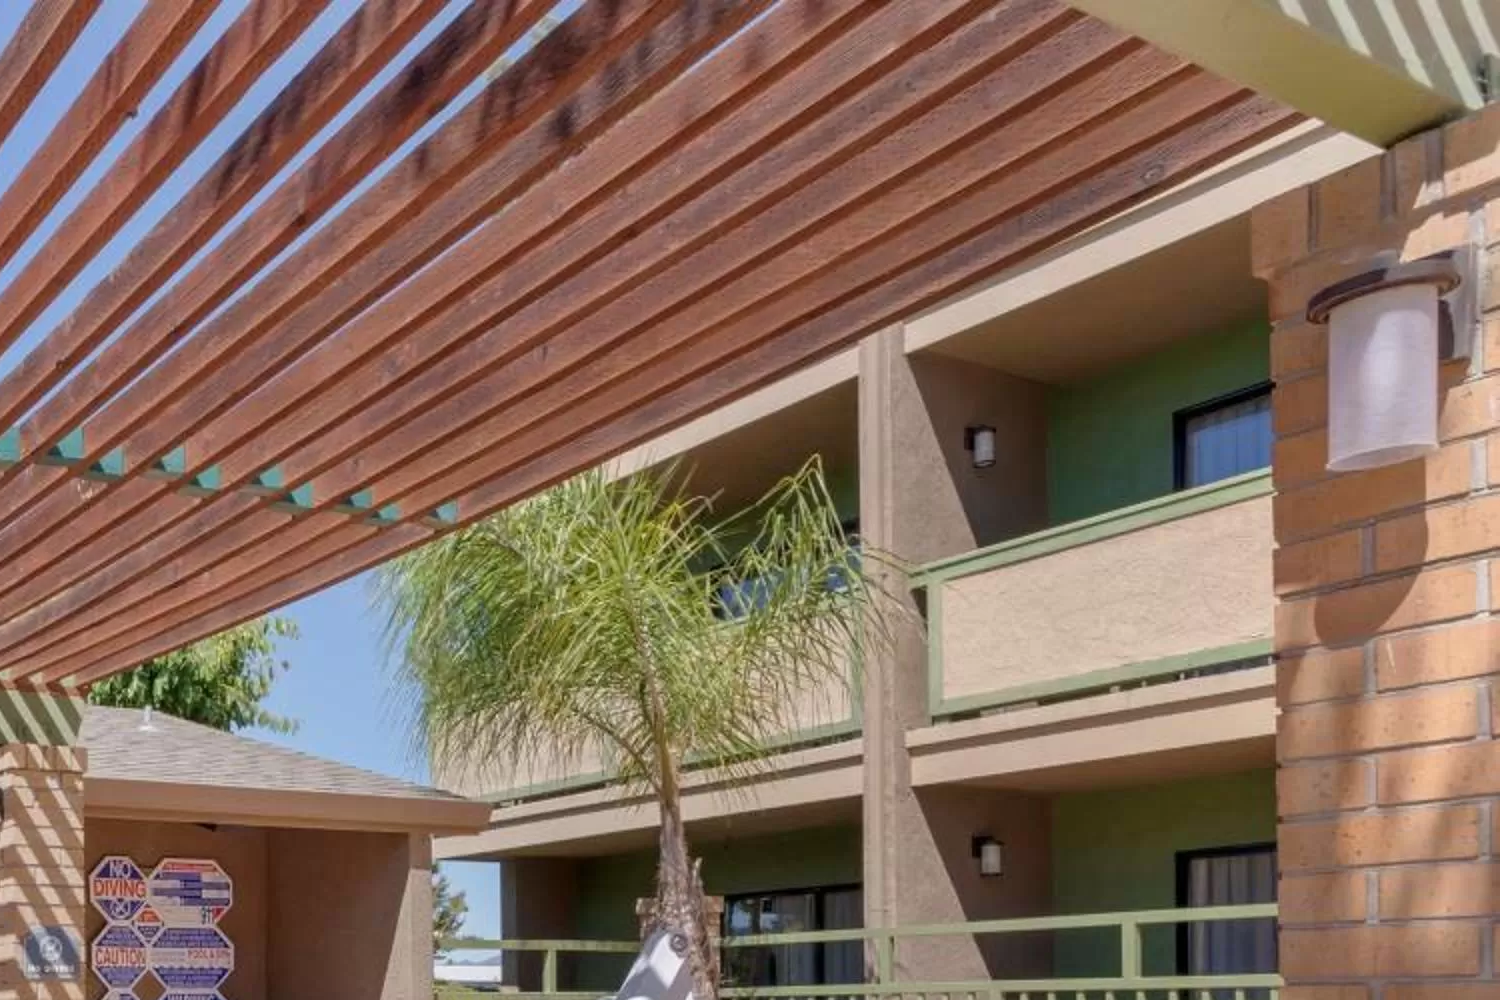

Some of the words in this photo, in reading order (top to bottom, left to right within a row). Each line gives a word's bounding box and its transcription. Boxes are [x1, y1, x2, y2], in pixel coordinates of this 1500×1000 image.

[109, 860, 131, 877] NO
[93, 879, 147, 898] DIVING
[95, 948, 145, 966] CAUTION
